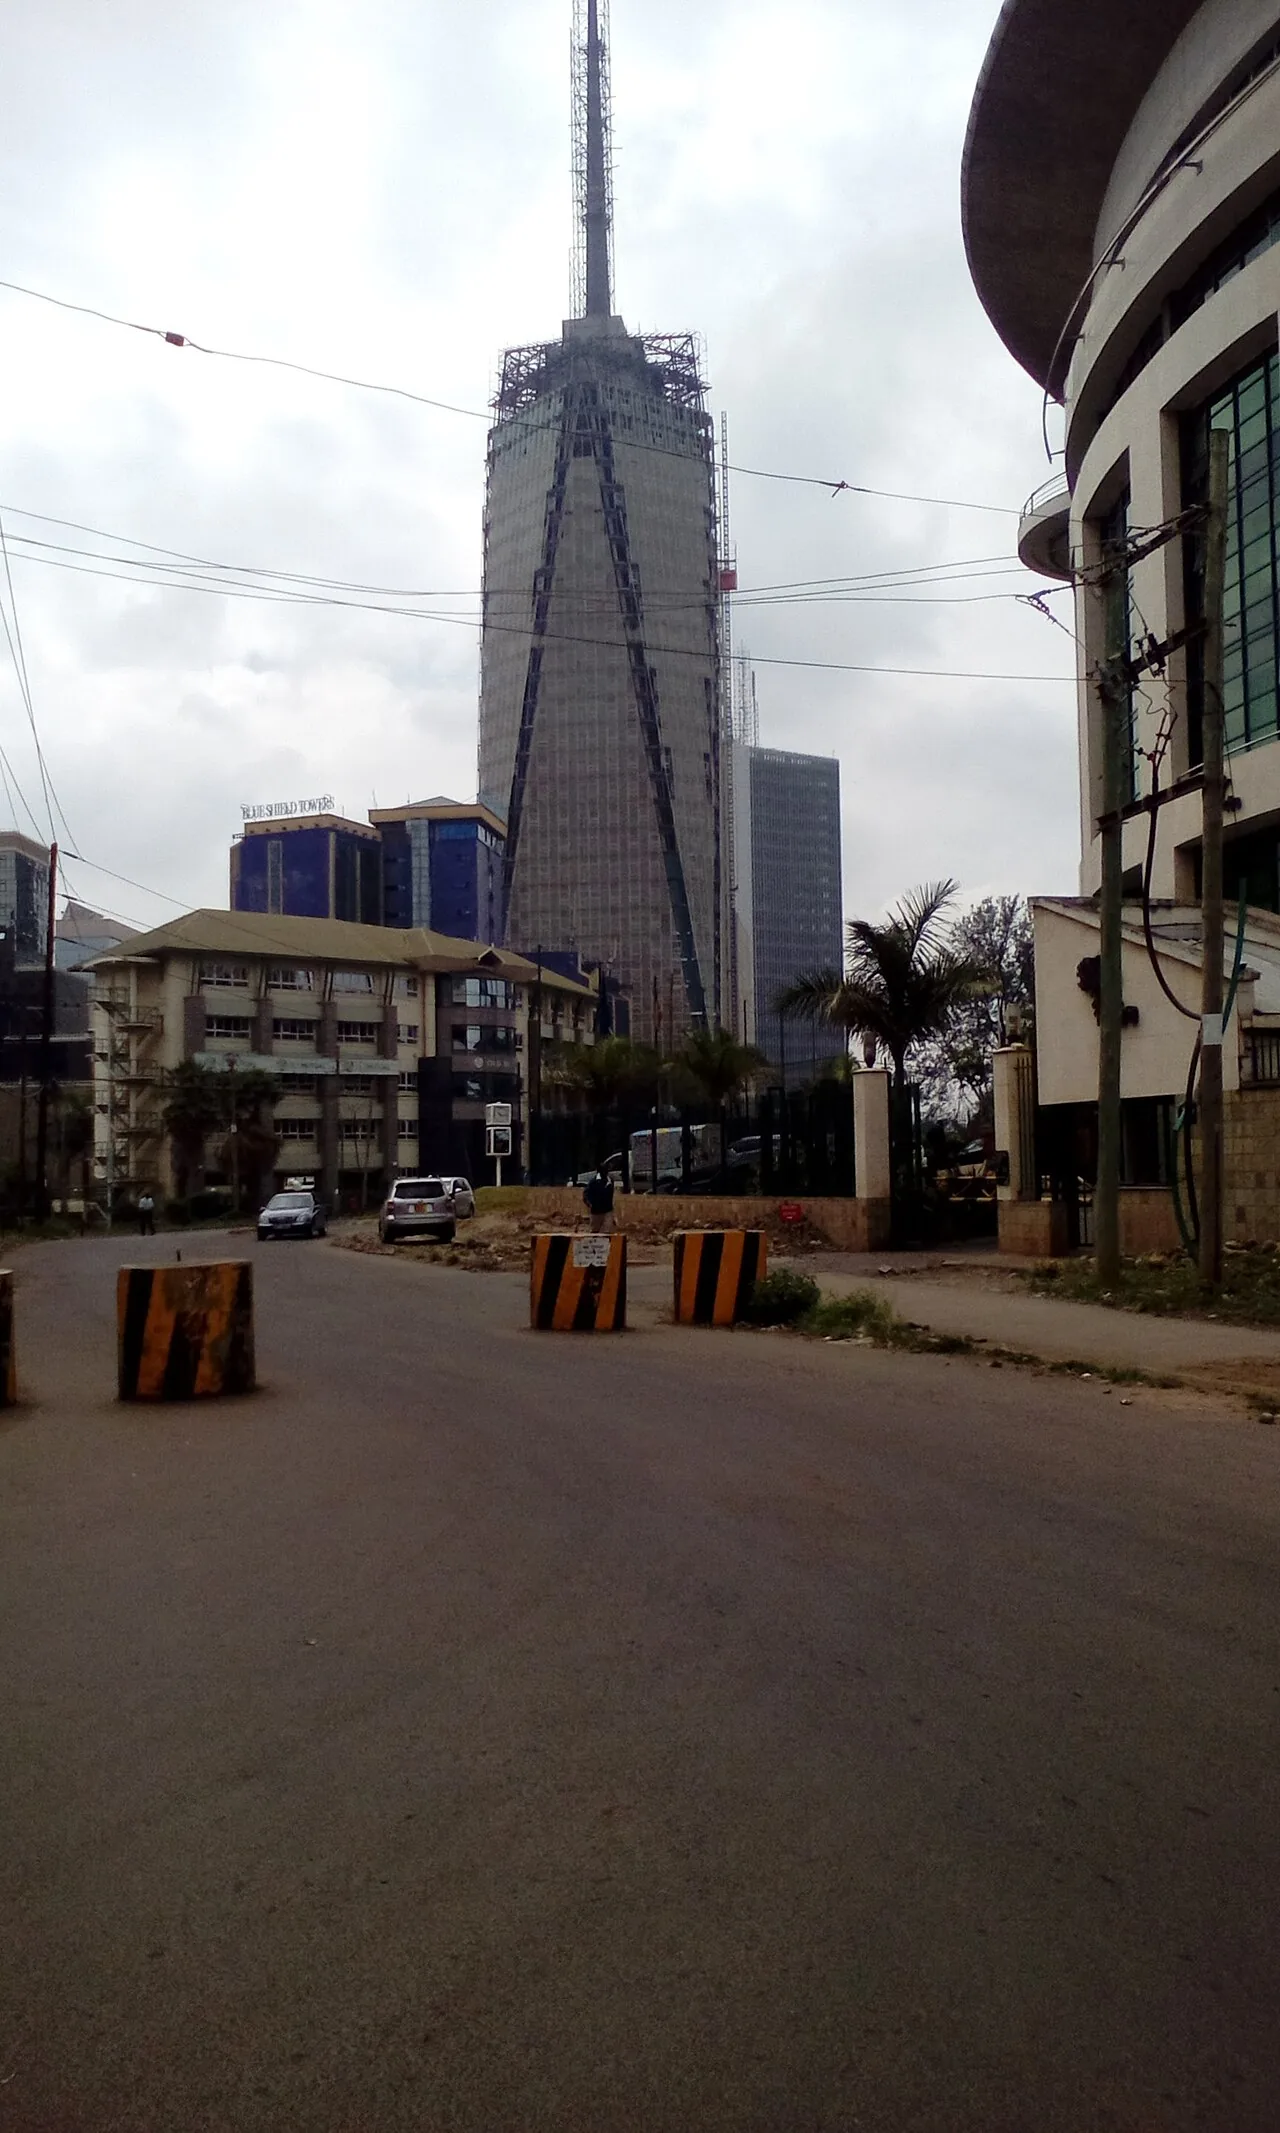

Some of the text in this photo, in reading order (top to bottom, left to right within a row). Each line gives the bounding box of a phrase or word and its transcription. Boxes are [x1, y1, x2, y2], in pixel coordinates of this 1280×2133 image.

[241, 796, 335, 819] BLUE SHIELD TOWERS
